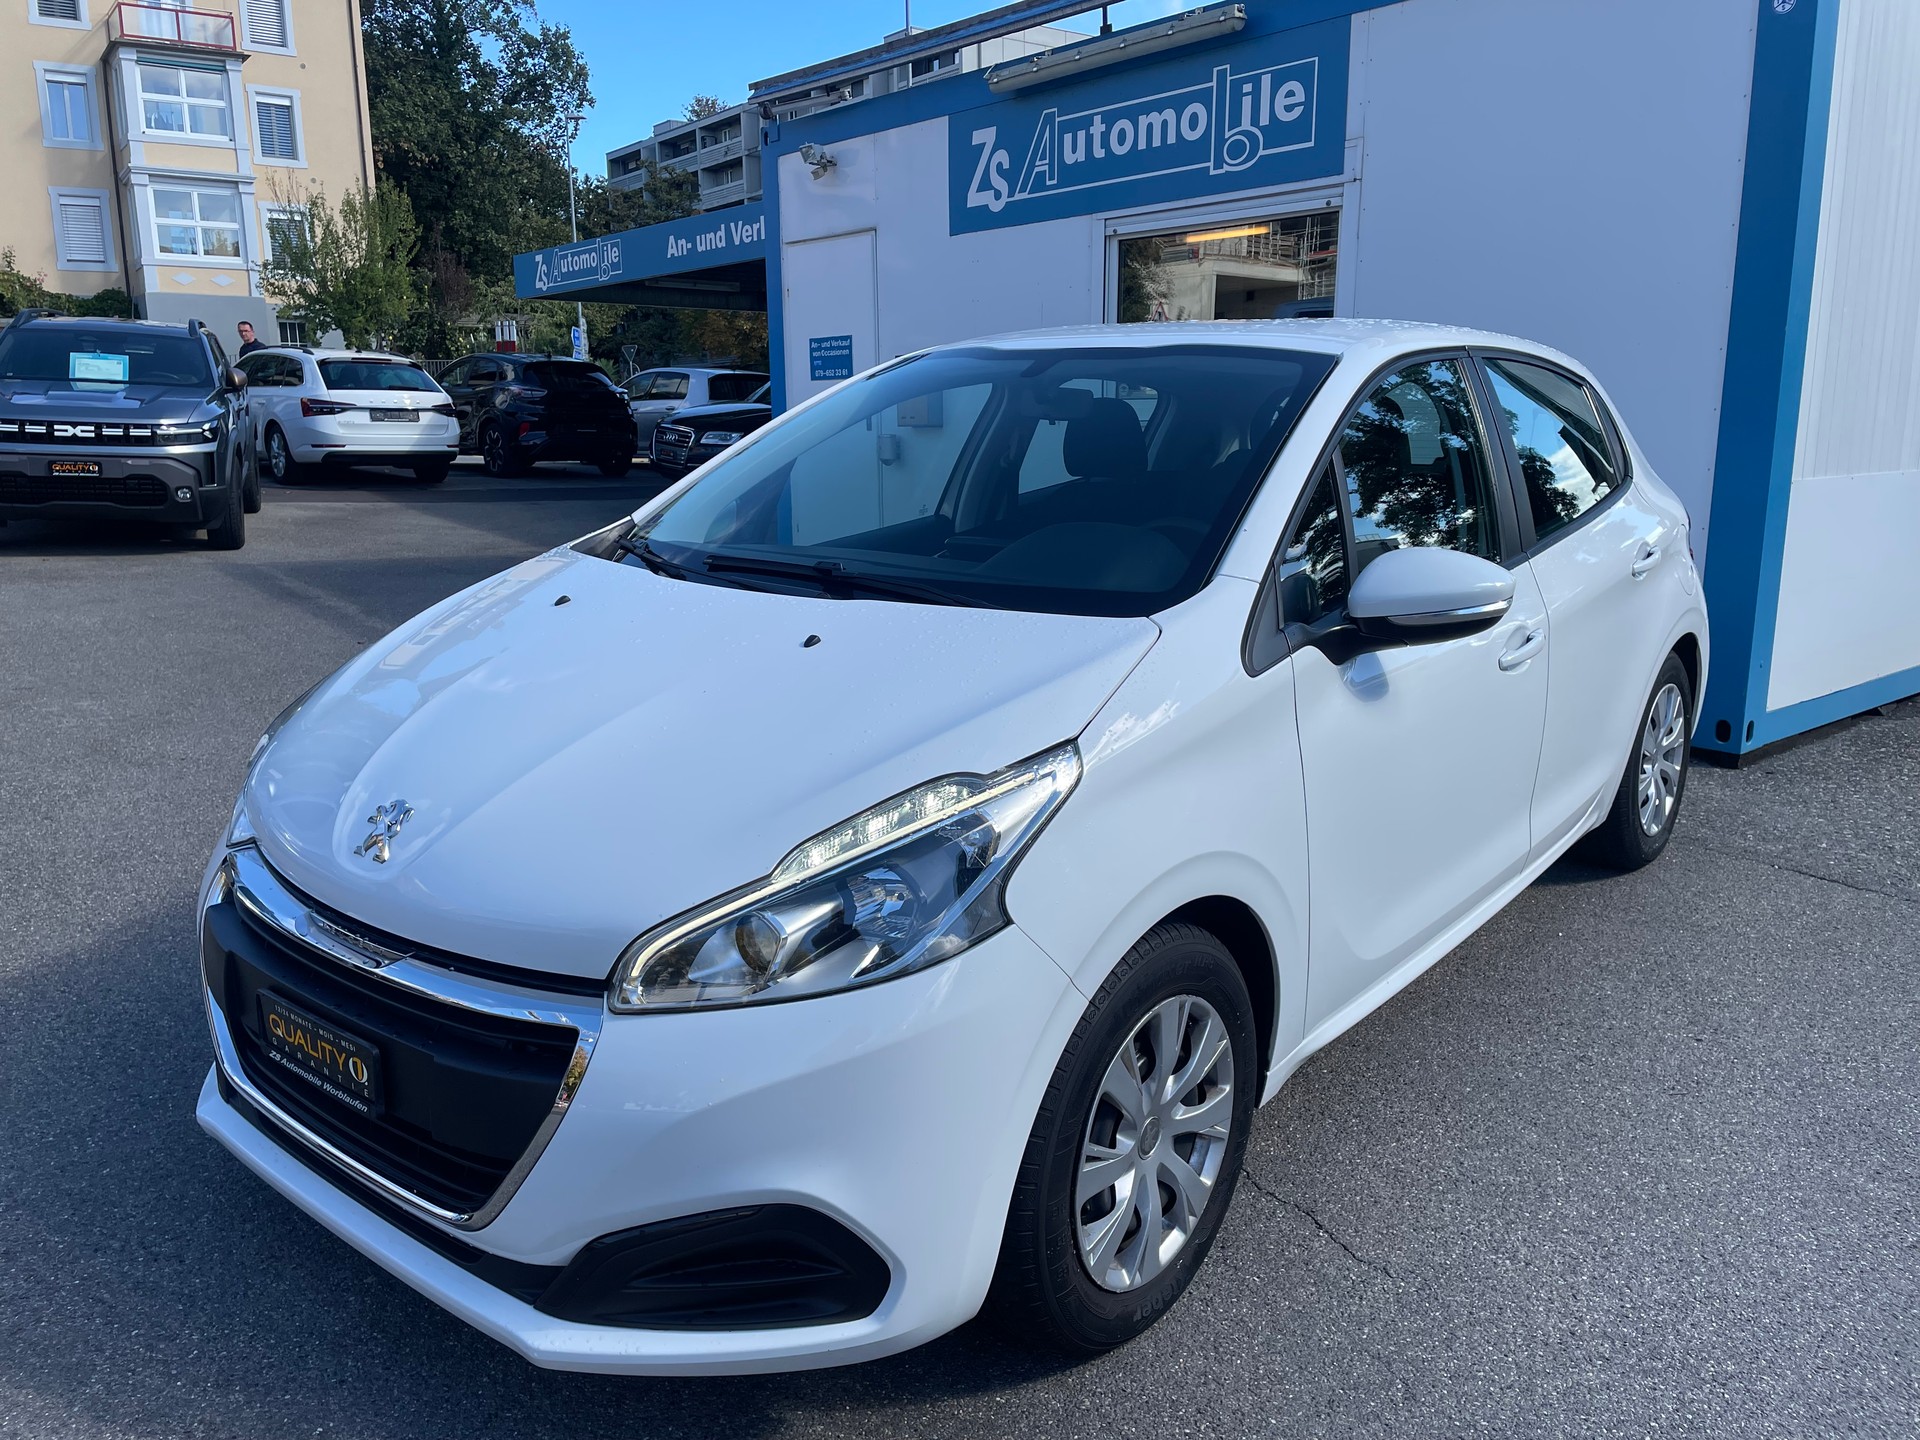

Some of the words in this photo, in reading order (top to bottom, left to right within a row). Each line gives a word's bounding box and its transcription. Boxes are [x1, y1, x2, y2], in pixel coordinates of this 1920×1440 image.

[1015, 64, 1306, 198] Automobile
[549, 239, 619, 285] Automobile
[667, 234, 692, 259] An-
[696, 223, 726, 252] und
[269, 1013, 347, 1072] QUALITY
[290, 1013, 312, 1030] MONATE
[318, 1028, 334, 1041] MOIS
[341, 1039, 356, 1052] MESI
[268, 1049, 282, 1062] ZS
[281, 1057, 322, 1087] Automobile
[323, 1081, 369, 1113] Worblaufen
